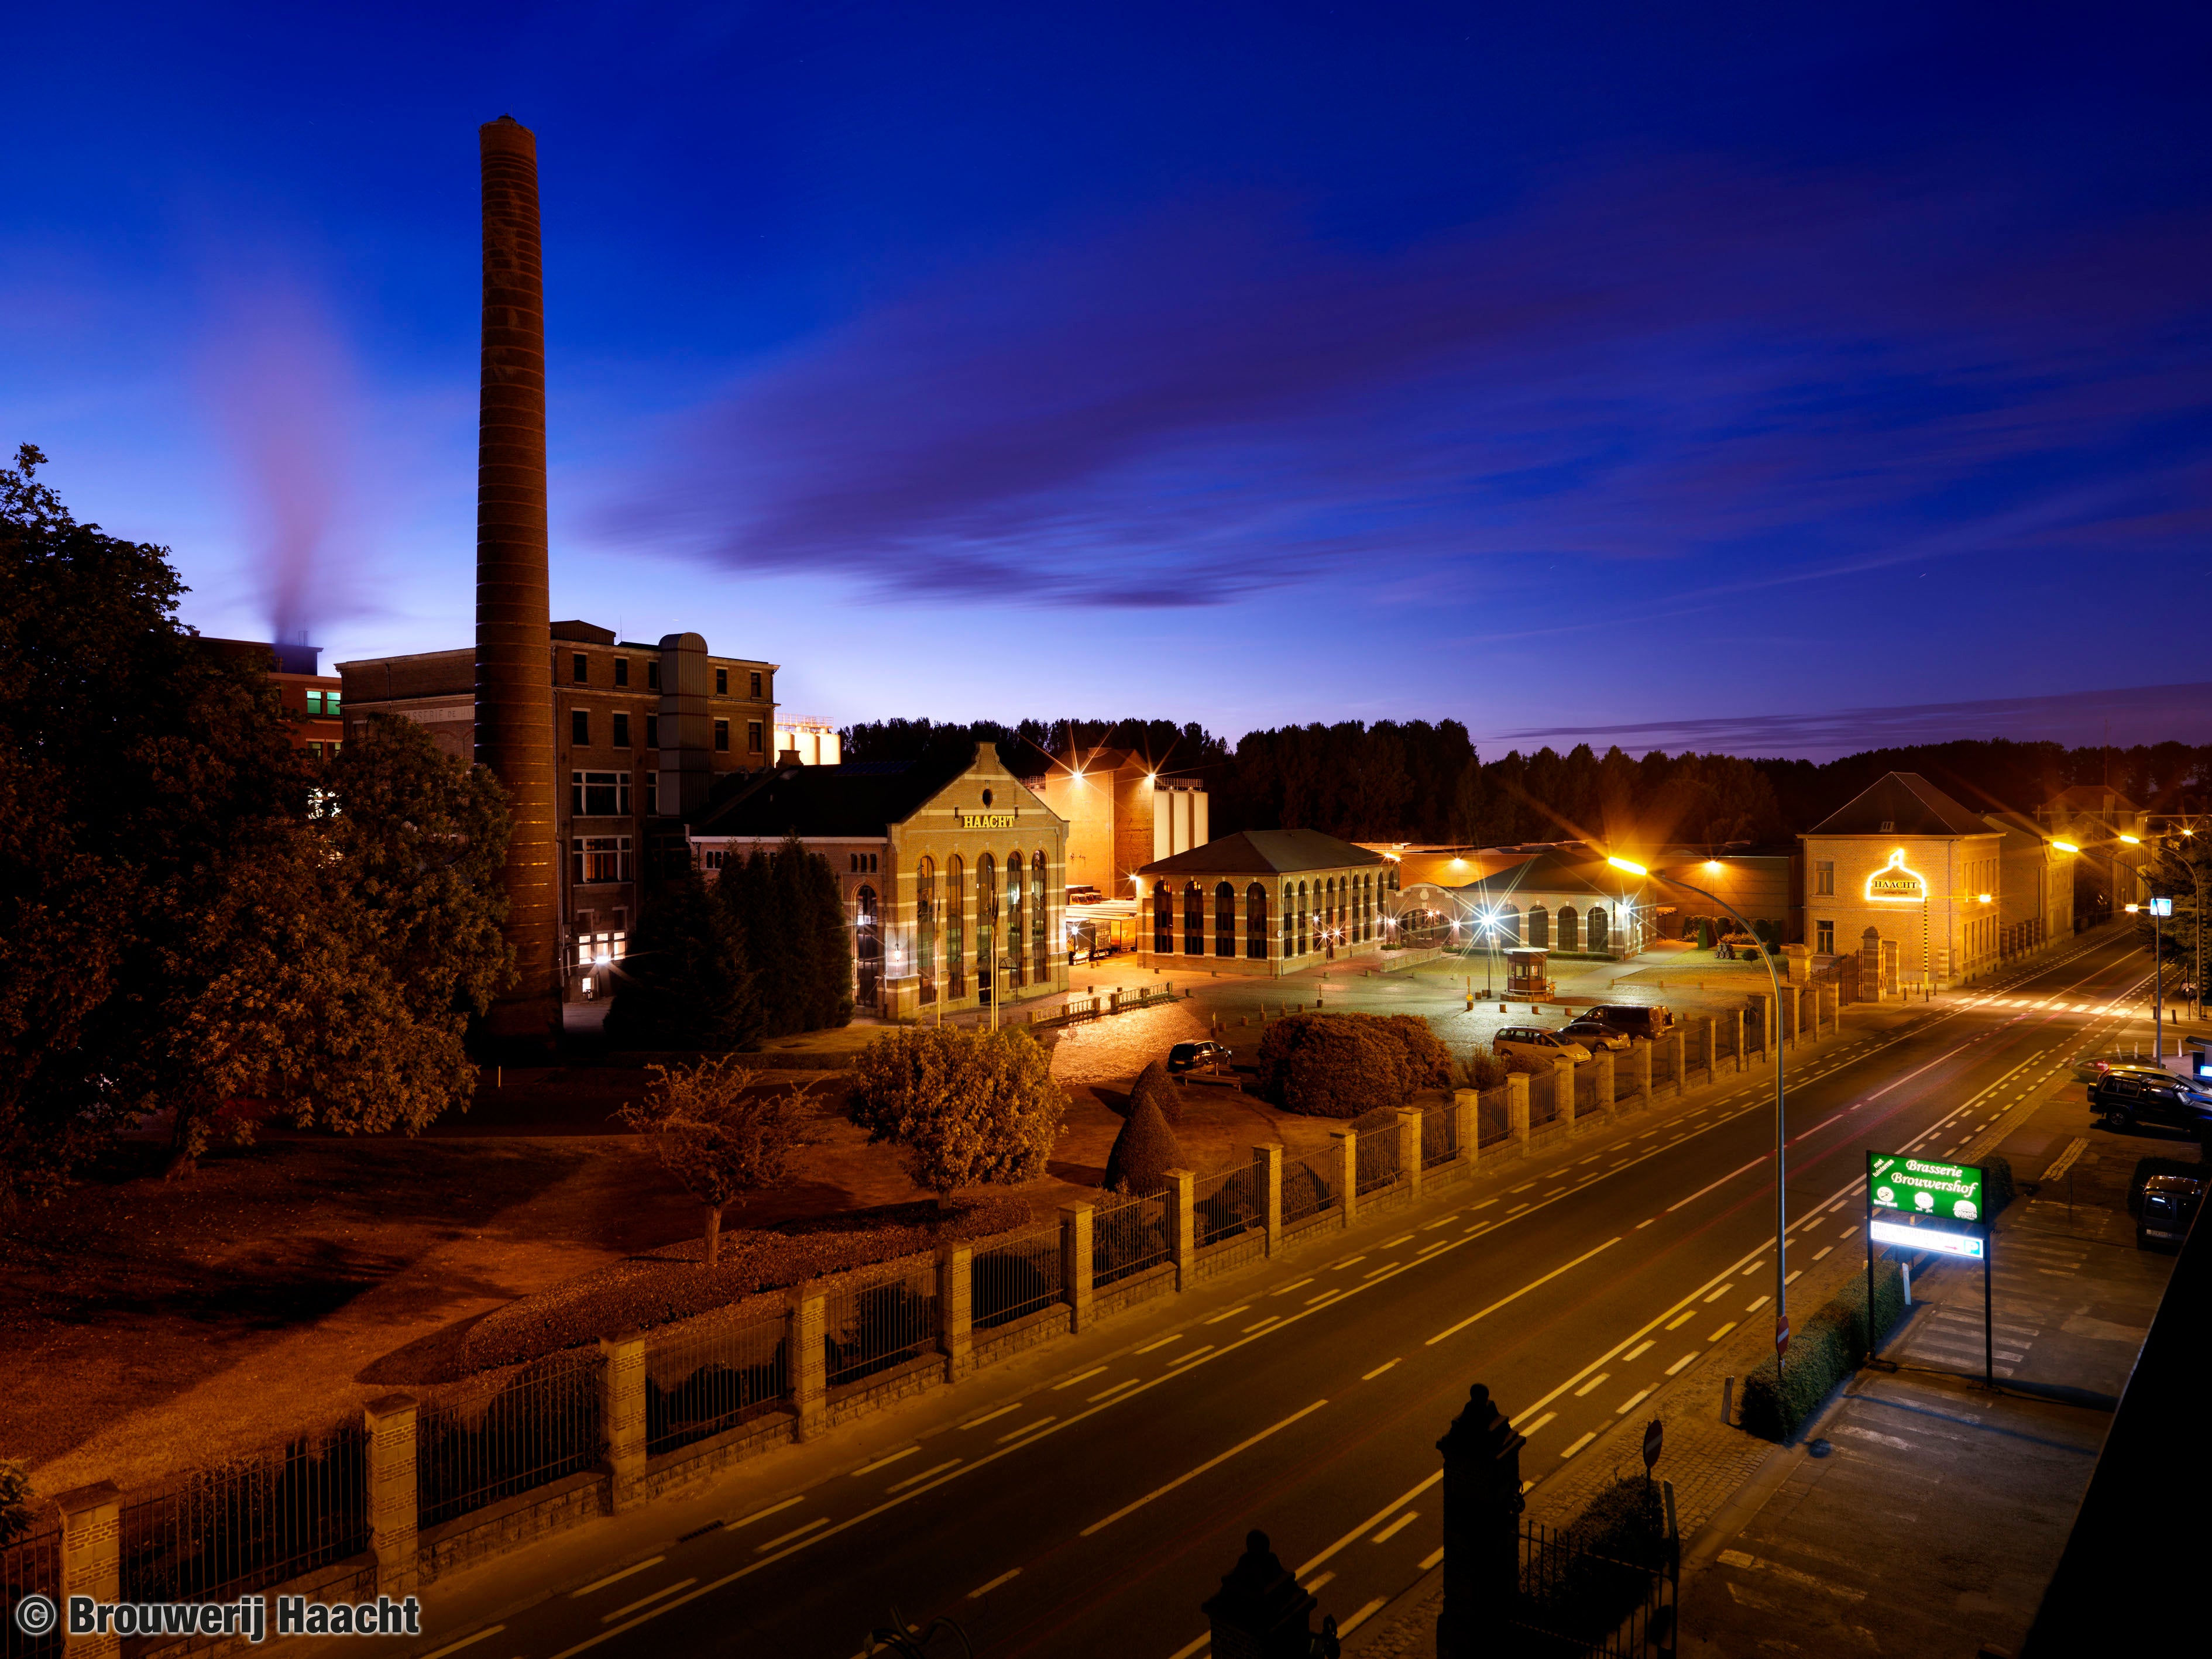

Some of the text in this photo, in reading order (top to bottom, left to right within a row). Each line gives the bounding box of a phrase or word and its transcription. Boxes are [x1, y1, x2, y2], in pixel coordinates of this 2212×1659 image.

[963, 815, 1015, 829] HAACHT
[1874, 880, 1917, 889] HAACHT
[1905, 1160, 1963, 1178] Brasserie
[1891, 1172, 1979, 1198] Brouwershof
